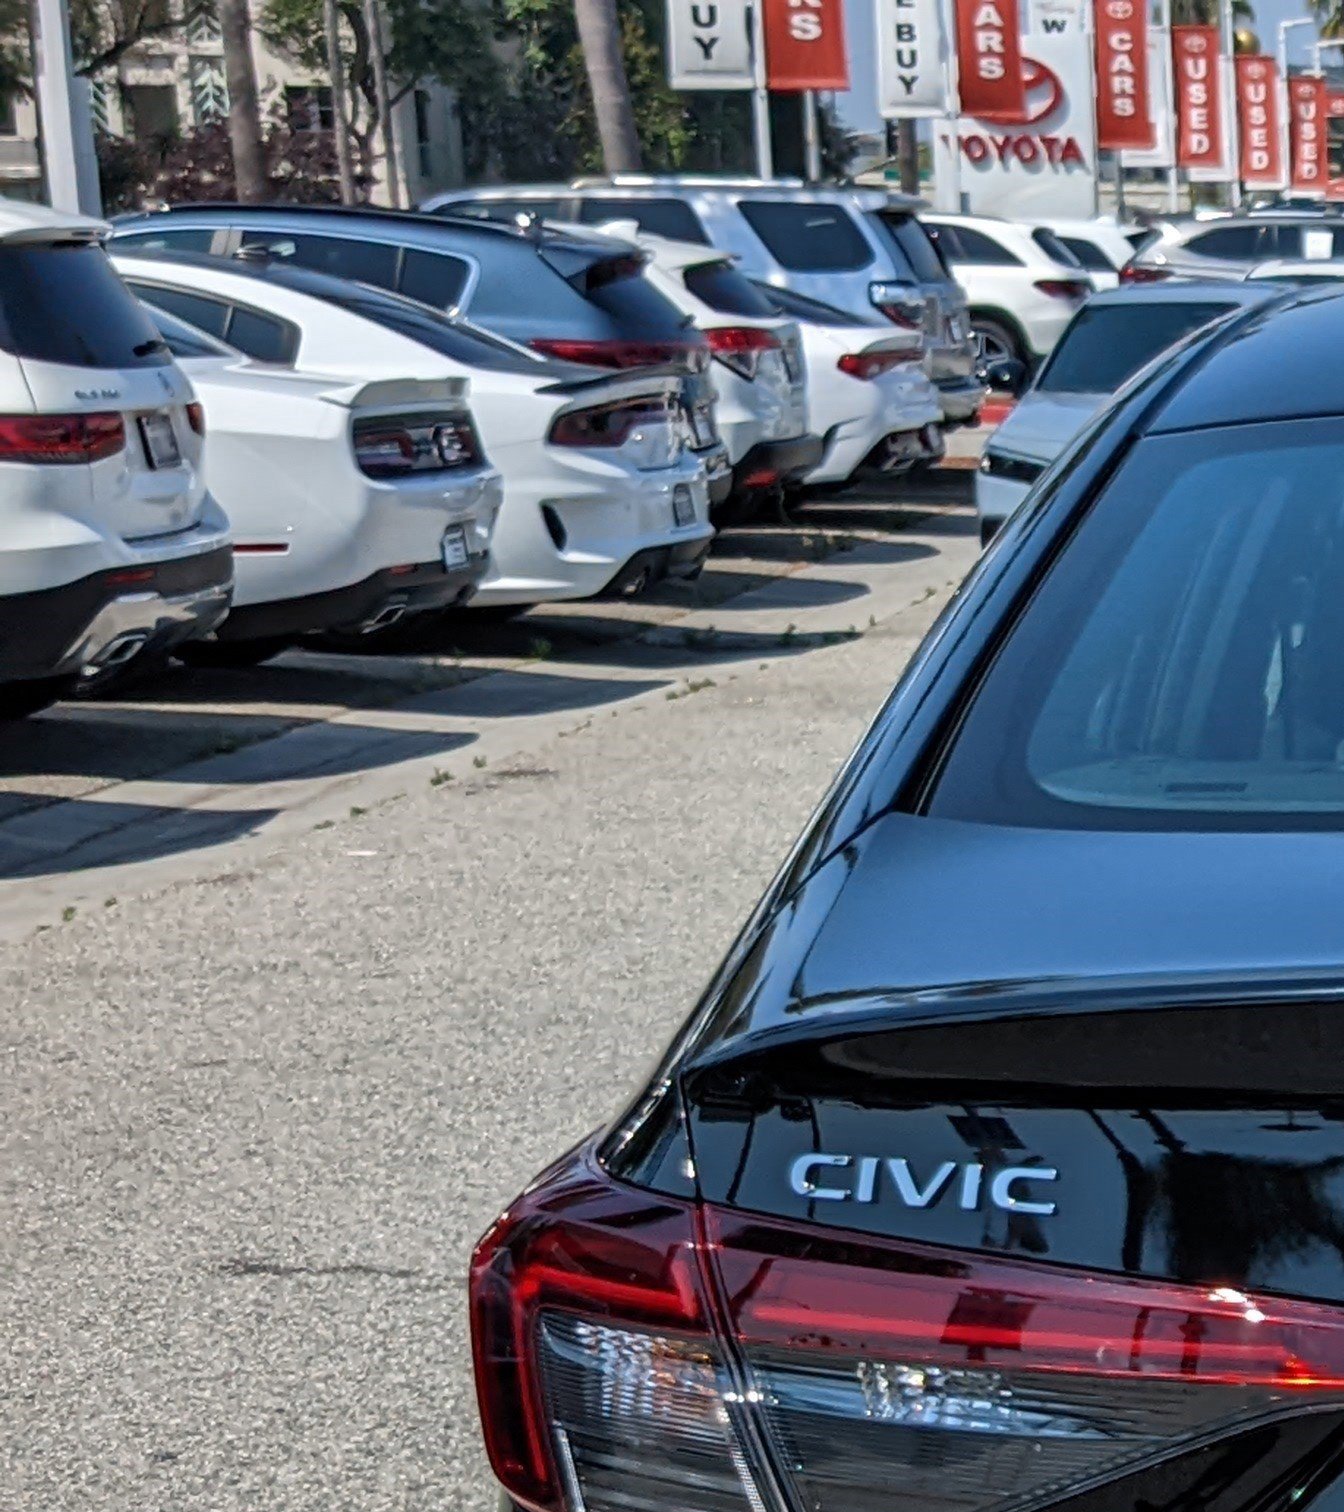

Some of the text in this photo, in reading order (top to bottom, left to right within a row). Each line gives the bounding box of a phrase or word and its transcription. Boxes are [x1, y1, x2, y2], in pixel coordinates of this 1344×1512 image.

[896, 23, 918, 95] BUY
[1109, 32, 1135, 117] CARS
[1184, 57, 1210, 154] USED
[1245, 83, 1269, 170] USED
[1299, 102, 1318, 180] USED
[791, 1153, 1057, 1215] CIVIC
